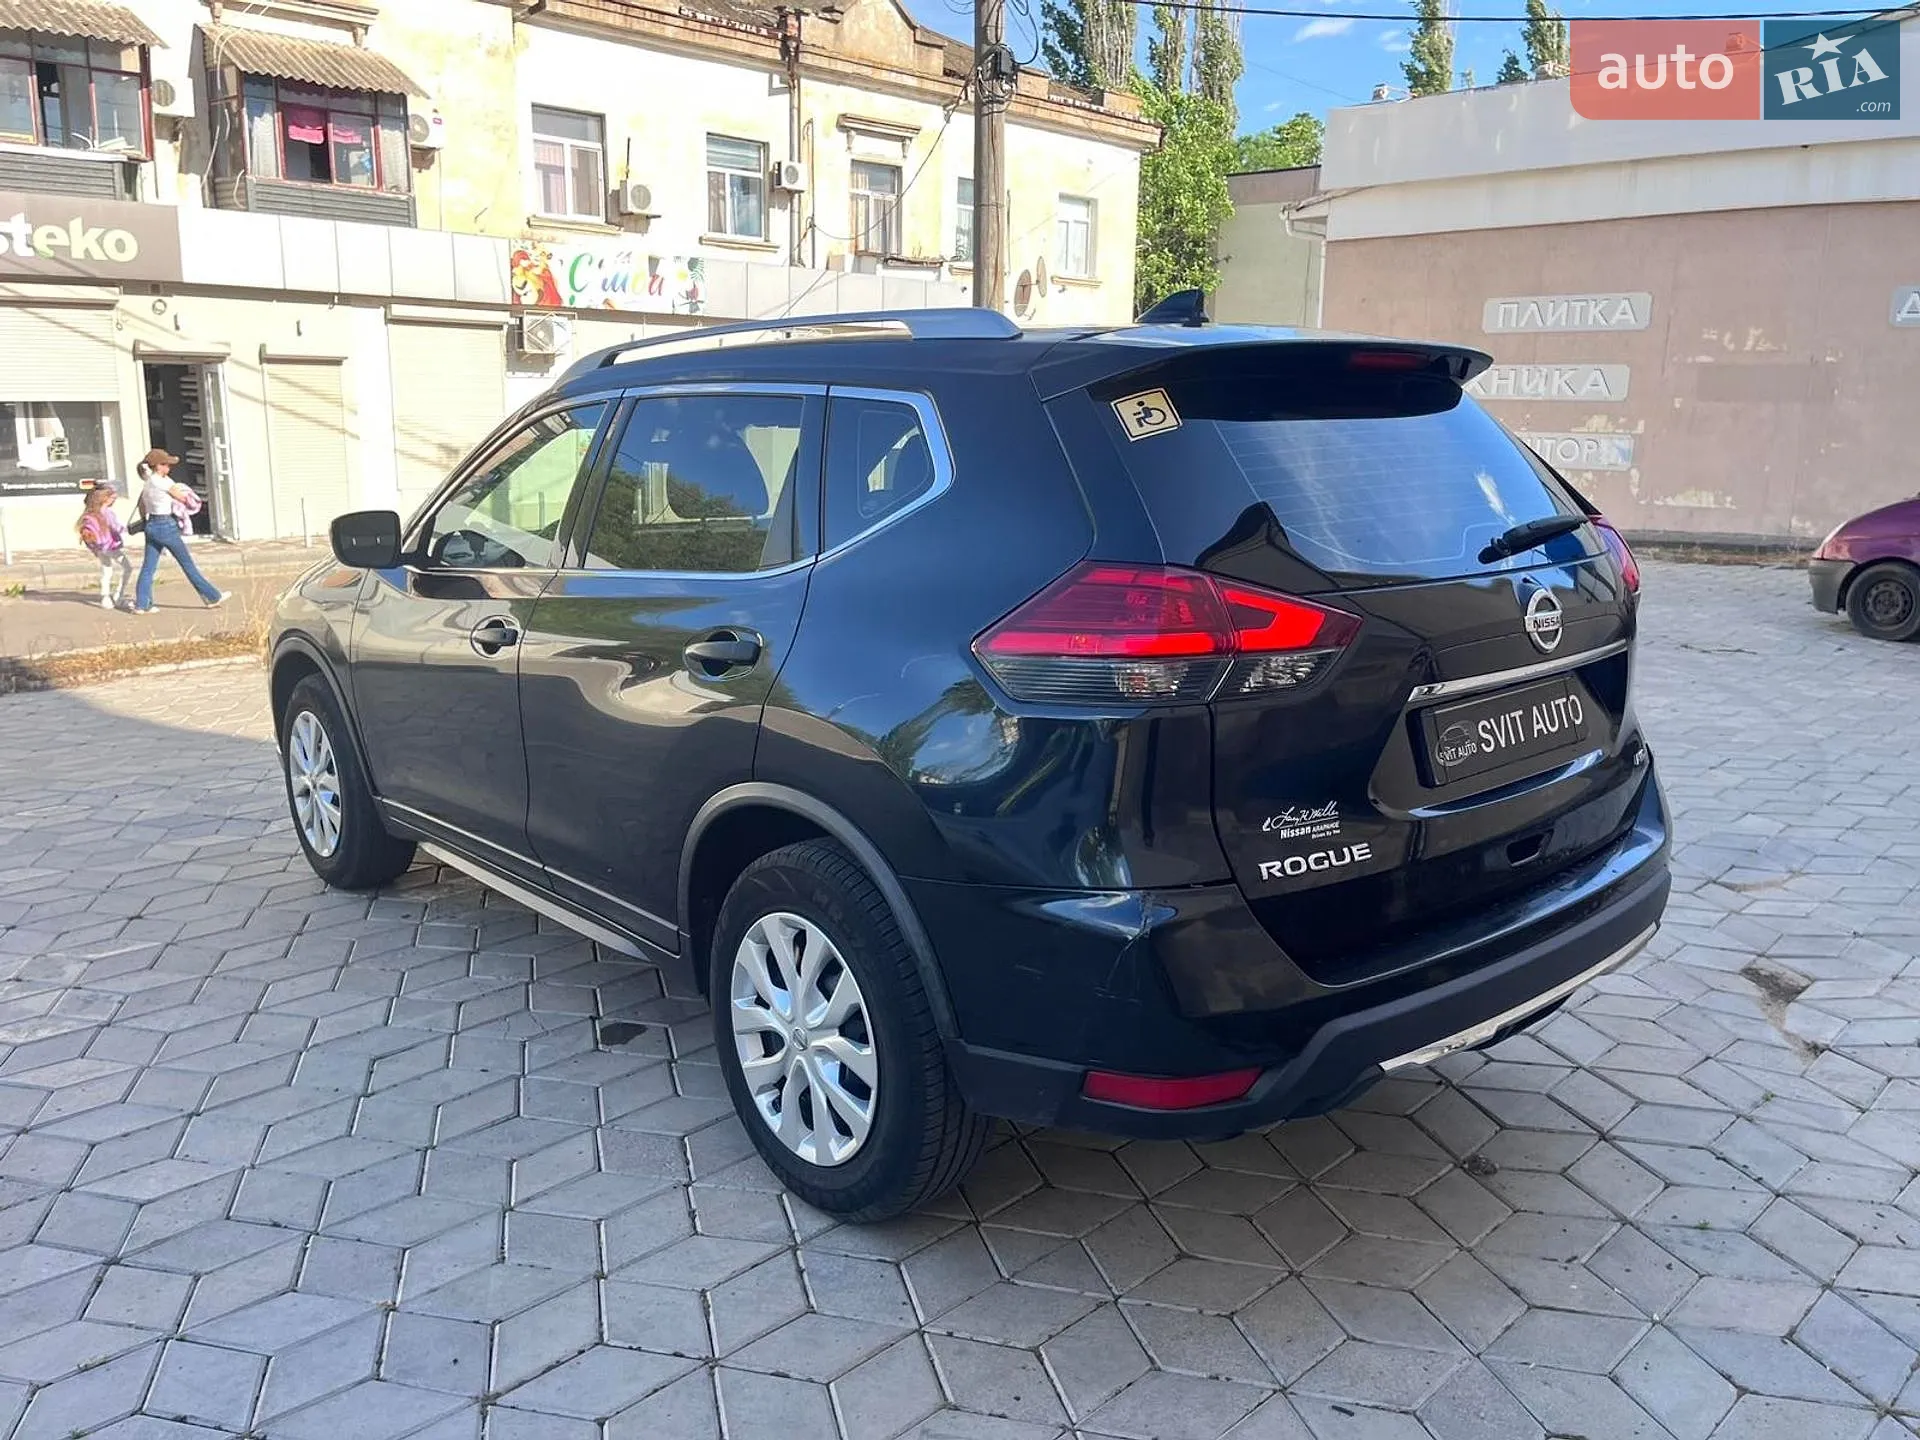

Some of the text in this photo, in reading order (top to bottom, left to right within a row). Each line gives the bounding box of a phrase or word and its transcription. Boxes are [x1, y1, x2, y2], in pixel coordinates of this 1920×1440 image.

[1498, 297, 1639, 328] ПЛИТКА
[1533, 615, 1562, 629] NISSA
[1477, 694, 1583, 753] SVIT AUTO
[1280, 826, 1311, 840] Nissan
[1258, 842, 1373, 881] ROGUE
